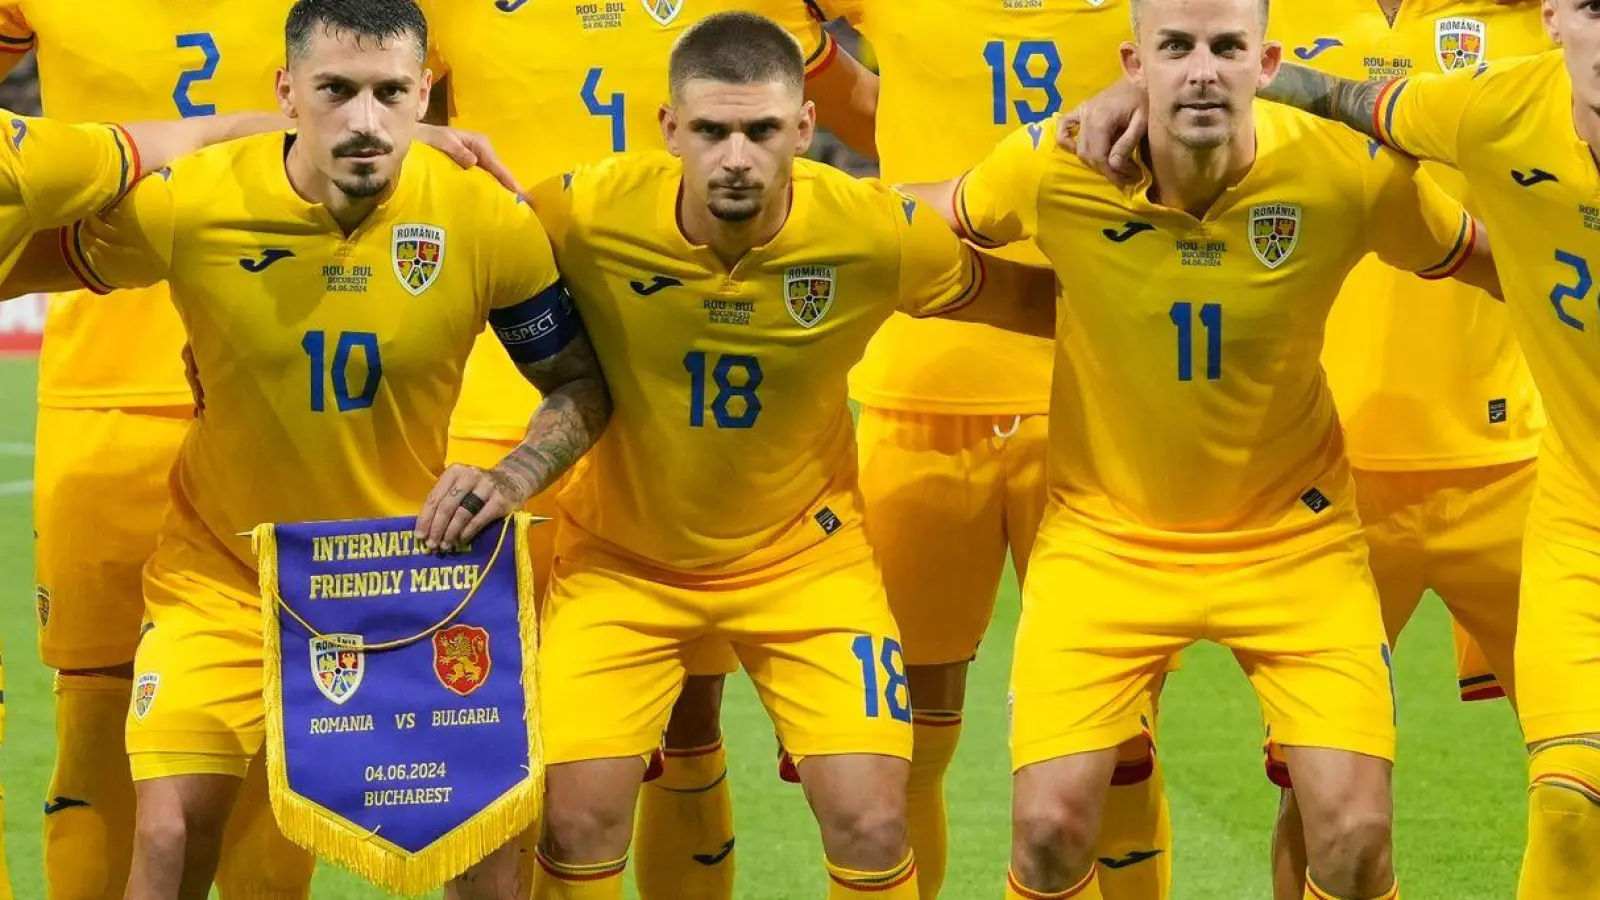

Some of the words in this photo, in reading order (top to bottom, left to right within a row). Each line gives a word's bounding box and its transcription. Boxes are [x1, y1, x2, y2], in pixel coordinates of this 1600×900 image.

[576, 4, 598, 15] ROU
[606, 2, 627, 13] BUL
[173, 32, 220, 119] 2
[1364, 57, 1385, 67] ROU
[1393, 58, 1414, 69] BUL
[984, 40, 1063, 125] 19
[580, 67, 626, 152] 4
[1176, 240, 1198, 250] ROU
[1207, 241, 1229, 252] BUL
[322, 265, 345, 276] ROU
[352, 265, 374, 277] BUL
[1170, 301, 1222, 381] 11
[302, 330, 381, 413] 10
[685, 351, 762, 429] 18
[309, 570, 404, 600] FRIENDLY
[410, 564, 480, 593] MATCH
[851, 635, 912, 724] 18
[310, 713, 375, 735] ROMANIA
[395, 712, 416, 730] VS
[431, 706, 501, 727] BULGARIA
[364, 761, 446, 781] 04.06.2024
[363, 787, 453, 807] BUCHAREST
